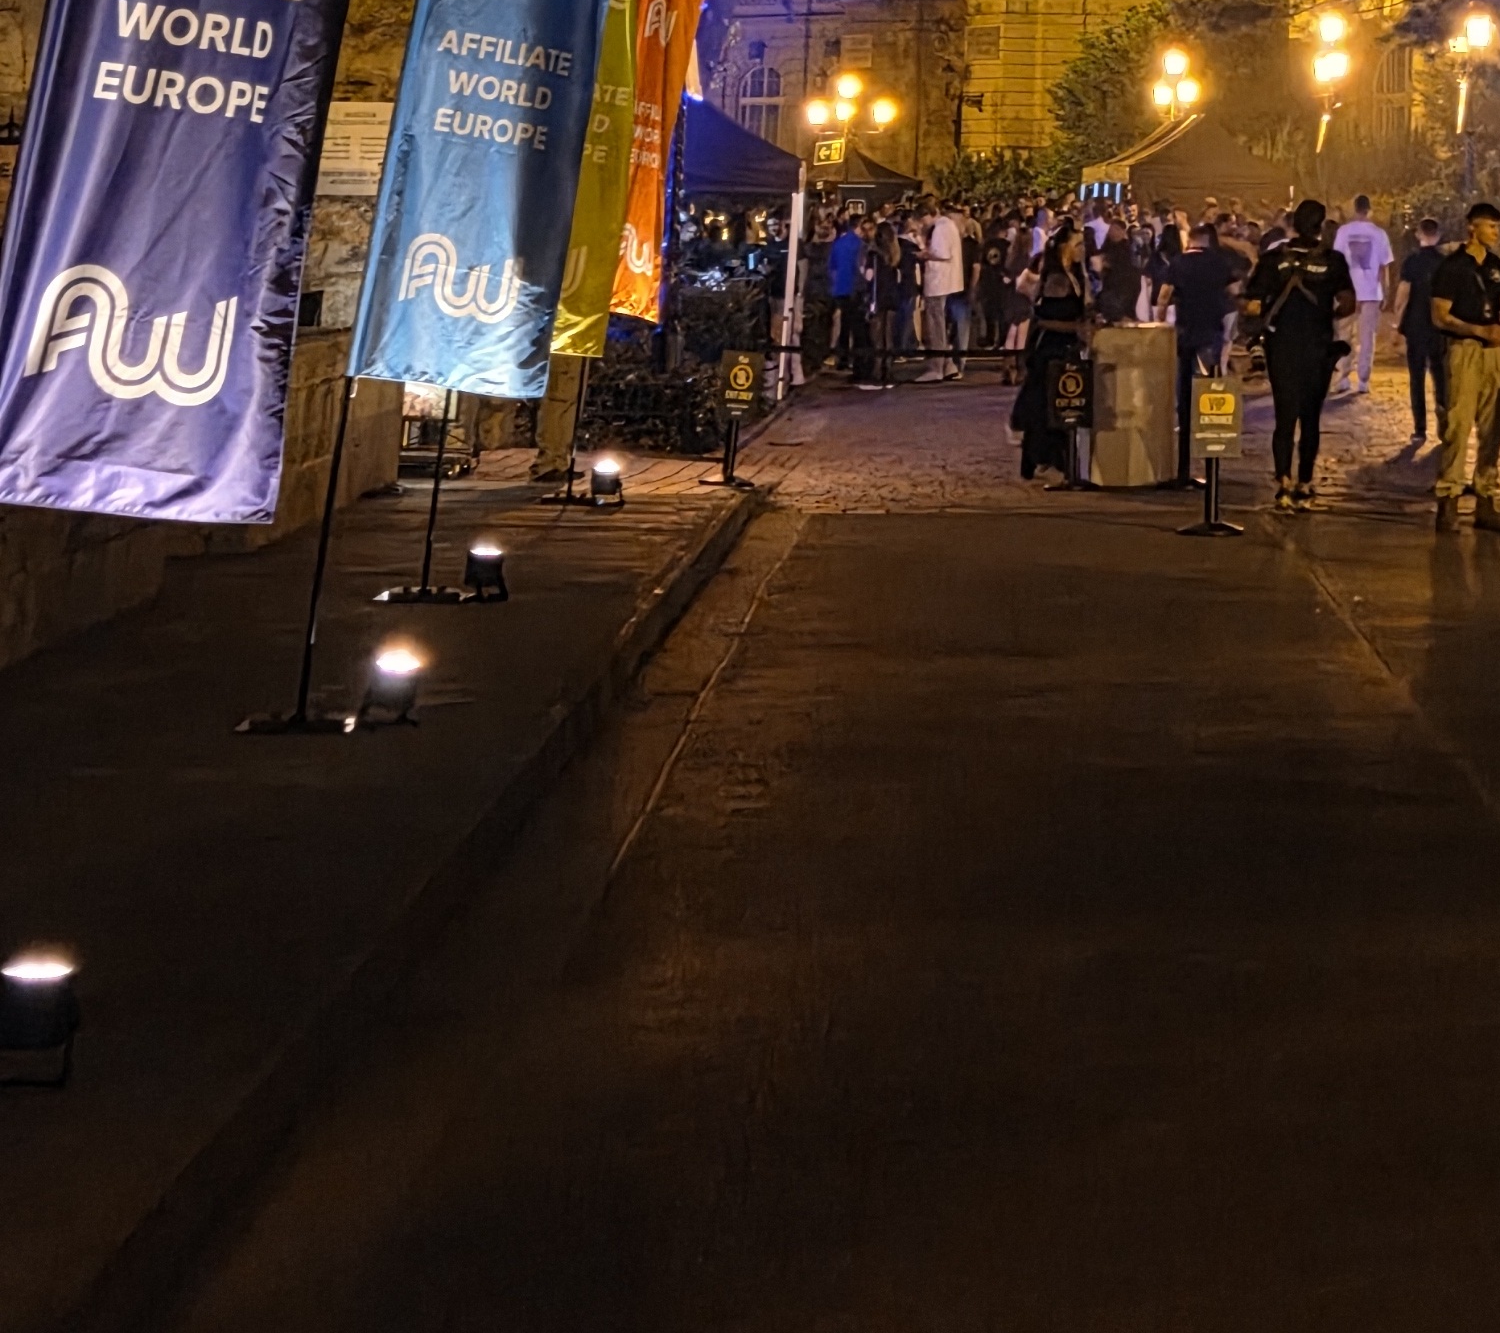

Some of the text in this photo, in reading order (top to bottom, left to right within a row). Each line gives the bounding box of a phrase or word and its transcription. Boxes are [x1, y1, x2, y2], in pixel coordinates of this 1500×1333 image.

[117, 0, 273, 59] WORLD
[437, 29, 573, 77] AFFILIATE
[92, 61, 270, 124] EUROPE
[449, 69, 553, 110] WORLD
[434, 107, 549, 151] EUROPE
